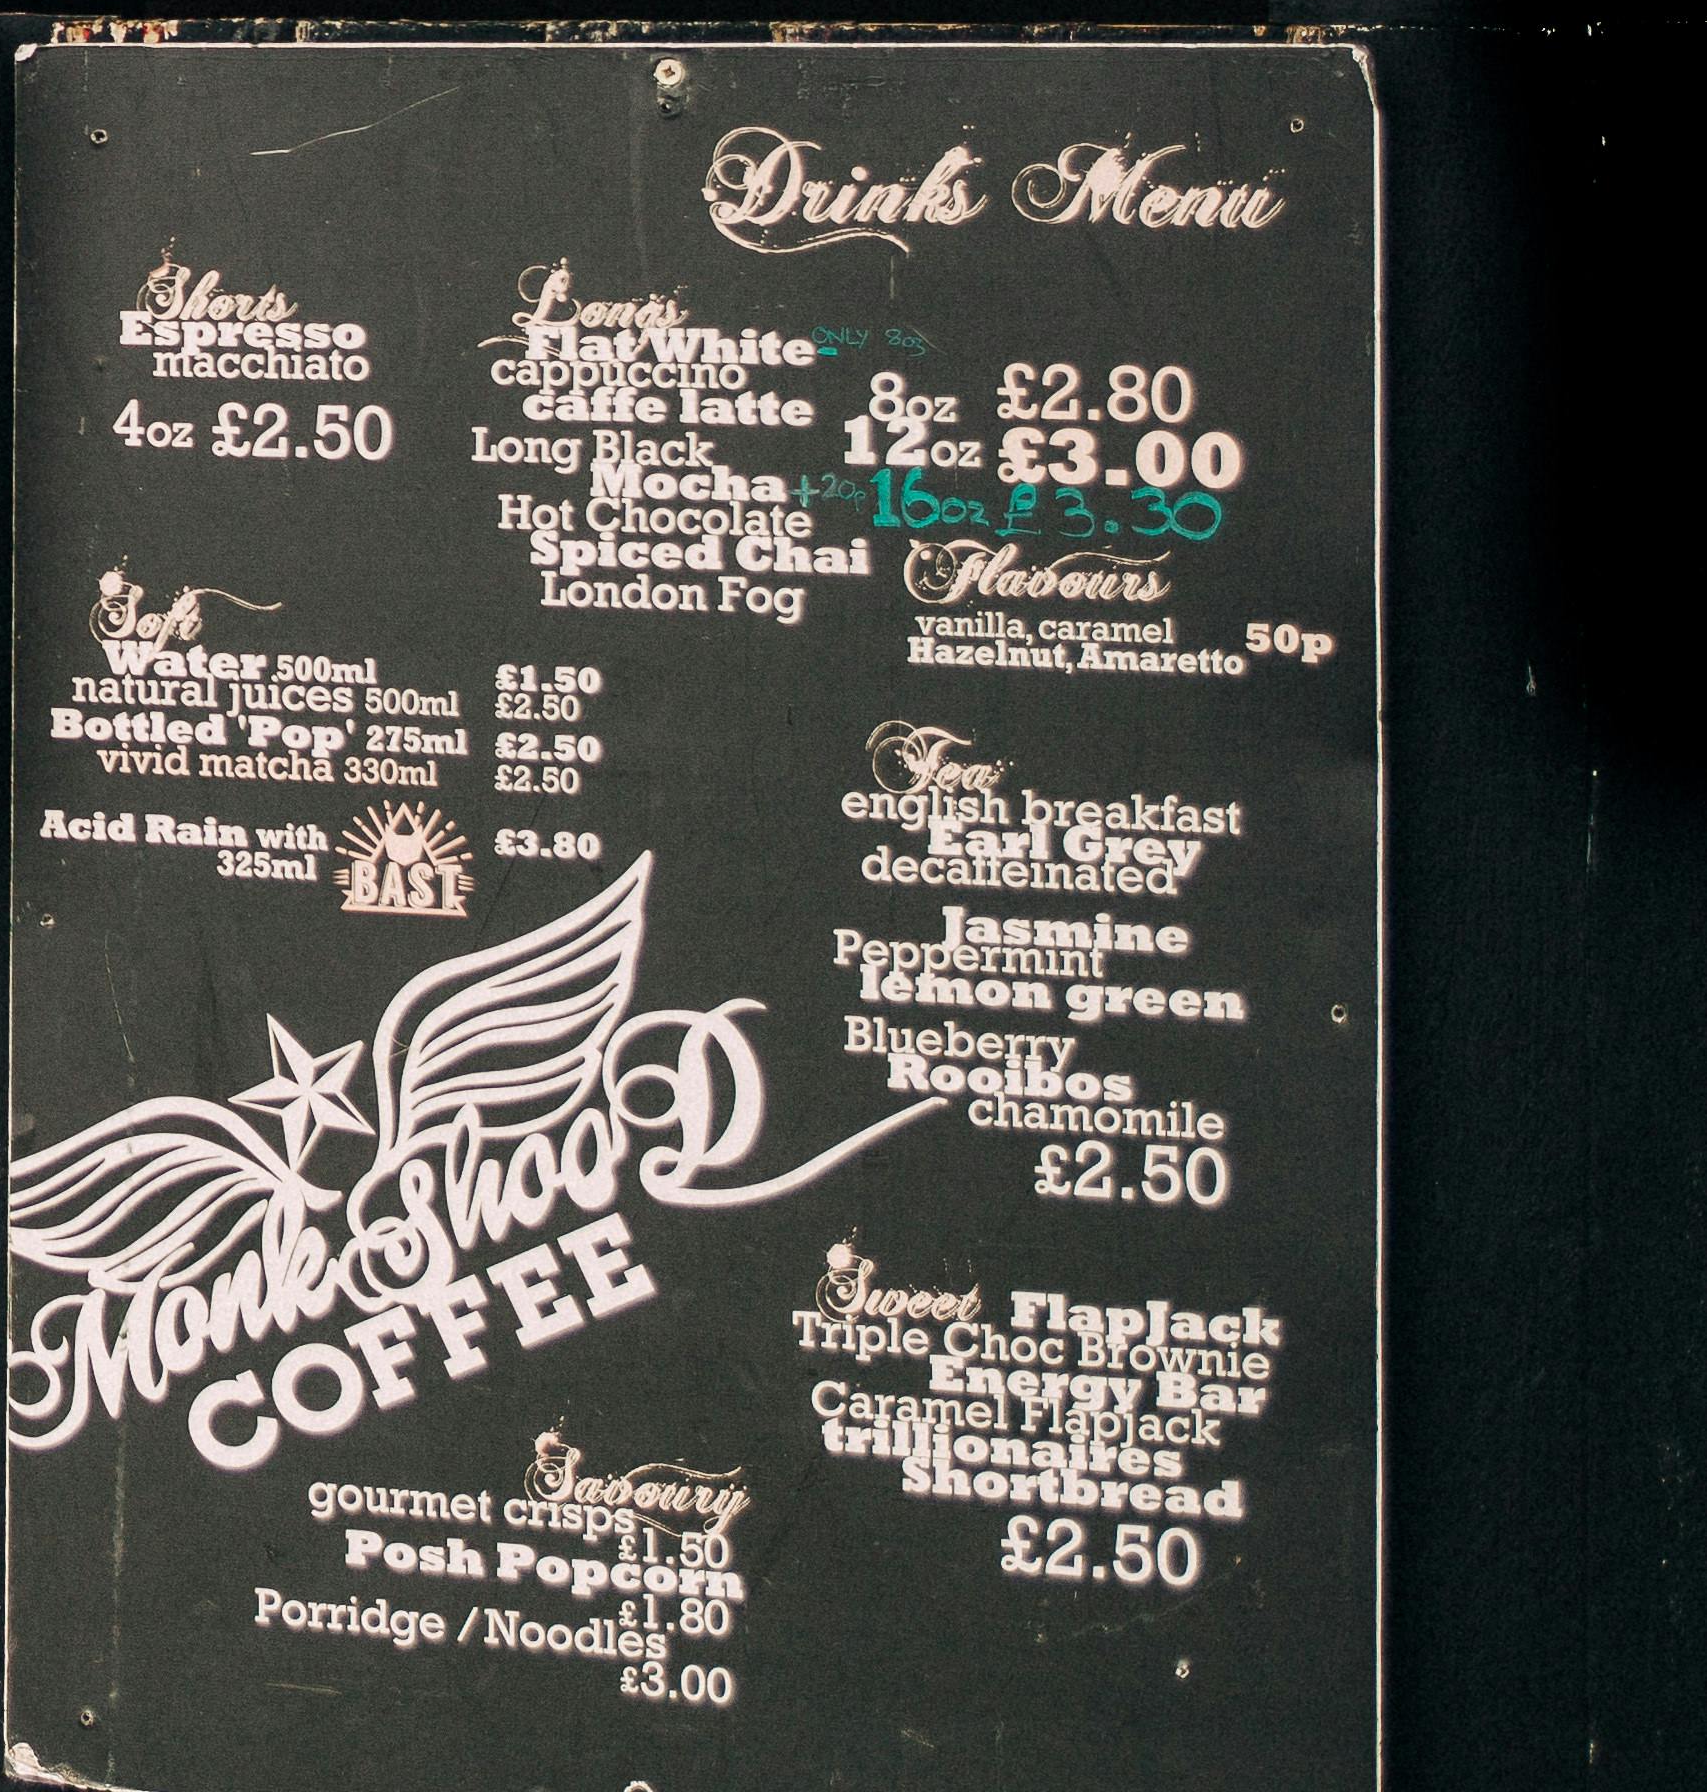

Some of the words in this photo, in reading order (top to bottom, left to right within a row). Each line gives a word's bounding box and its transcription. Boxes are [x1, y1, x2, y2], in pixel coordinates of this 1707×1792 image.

[701, 126, 987, 254] Drinks
[1012, 136, 1285, 229] Menu
[119, 311, 368, 354] Espresso
[524, 326, 639, 362] Flat
[645, 328, 817, 367] White
[153, 343, 371, 382] macchiato
[490, 358, 748, 395] cappuccino
[523, 387, 669, 424] caffe
[679, 389, 815, 427] latte
[868, 371, 959, 423] 8oz
[996, 362, 1196, 425] £2.80
[112, 399, 194, 449] 4oz
[211, 402, 394, 461] £2.50
[471, 426, 583, 475] Long
[591, 429, 716, 468] Black
[843, 414, 983, 468] 12oz
[997, 427, 1243, 490] £3.00
[590, 462, 790, 503] Mocha
[869, 465, 990, 529] 16oz
[498, 494, 575, 531] Hot
[586, 497, 814, 539] Chocolate
[530, 530, 724, 577] Spiced
[735, 534, 872, 575] Chai
[903, 538, 1172, 605] Flavours
[540, 570, 709, 611] London
[718, 575, 806, 625] Fog
[915, 611, 1034, 646] vanilla,
[1038, 616, 1173, 646] caramel
[1245, 622, 1334, 665] 50p
[102, 639, 269, 683] Water
[276, 655, 378, 686] 500ml
[494, 664, 603, 694] £1.50
[907, 637, 1074, 672] Hazelnut,
[1078, 642, 1245, 676] Amaretto
[72, 673, 218, 708] natural
[227, 680, 354, 719] juices
[365, 687, 461, 719] 500ml
[494, 693, 581, 722] £2.50
[50, 707, 228, 746] Bottled
[365, 725, 469, 757] 275ml
[494, 732, 603, 763] £2.50
[95, 745, 189, 776] vivid
[198, 749, 334, 784] matcha
[343, 757, 439, 788] 330ml
[494, 765, 581, 795] £2.50
[40, 809, 136, 844] Acid
[144, 812, 249, 847] Rain
[257, 823, 330, 853] with
[493, 828, 602, 861] £3.80
[841, 786, 1010, 831] english
[1021, 789, 1242, 836] breakfast
[216, 850, 318, 882] 325ml
[861, 845, 1178, 896] decaffeinated
[927, 818, 1052, 861] Earl
[1063, 823, 1202, 878] Grey
[350, 858, 465, 911] BAST
[833, 928, 1104, 981] Peppermint
[941, 905, 1189, 955] Jasmine
[858, 962, 1053, 1010] lemon
[1065, 983, 1245, 1023] green
[843, 1014, 1076, 1070] Blueberry
[887, 1052, 1135, 1102] Rooibos
[968, 1090, 1226, 1142] chamomile
[1034, 1140, 1228, 1206] £2.50
[188, 1211, 657, 1474] COFFEE
[792, 1310, 930, 1362] Triple
[943, 1321, 1066, 1366] Choc
[1077, 1330, 1271, 1381] Brownie
[929, 1354, 1142, 1415] Energy
[1155, 1369, 1267, 1416] Bar
[811, 1379, 1009, 1432] Caramel
[1020, 1394, 1222, 1449] Flapjack
[821, 1418, 1184, 1480] trillionaires
[308, 1480, 493, 1524] gourmet
[502, 1494, 637, 1541] crisps
[901, 1454, 1245, 1520] Shortbread
[344, 1528, 484, 1578] Posh
[496, 1540, 746, 1601] Popcorn
[617, 1527, 731, 1570] £1.50
[1000, 1514, 1201, 1588] £2.50
[253, 1585, 446, 1649] Porridge
[617, 1593, 732, 1637] £1.80
[618, 1660, 734, 1705] £3.00
